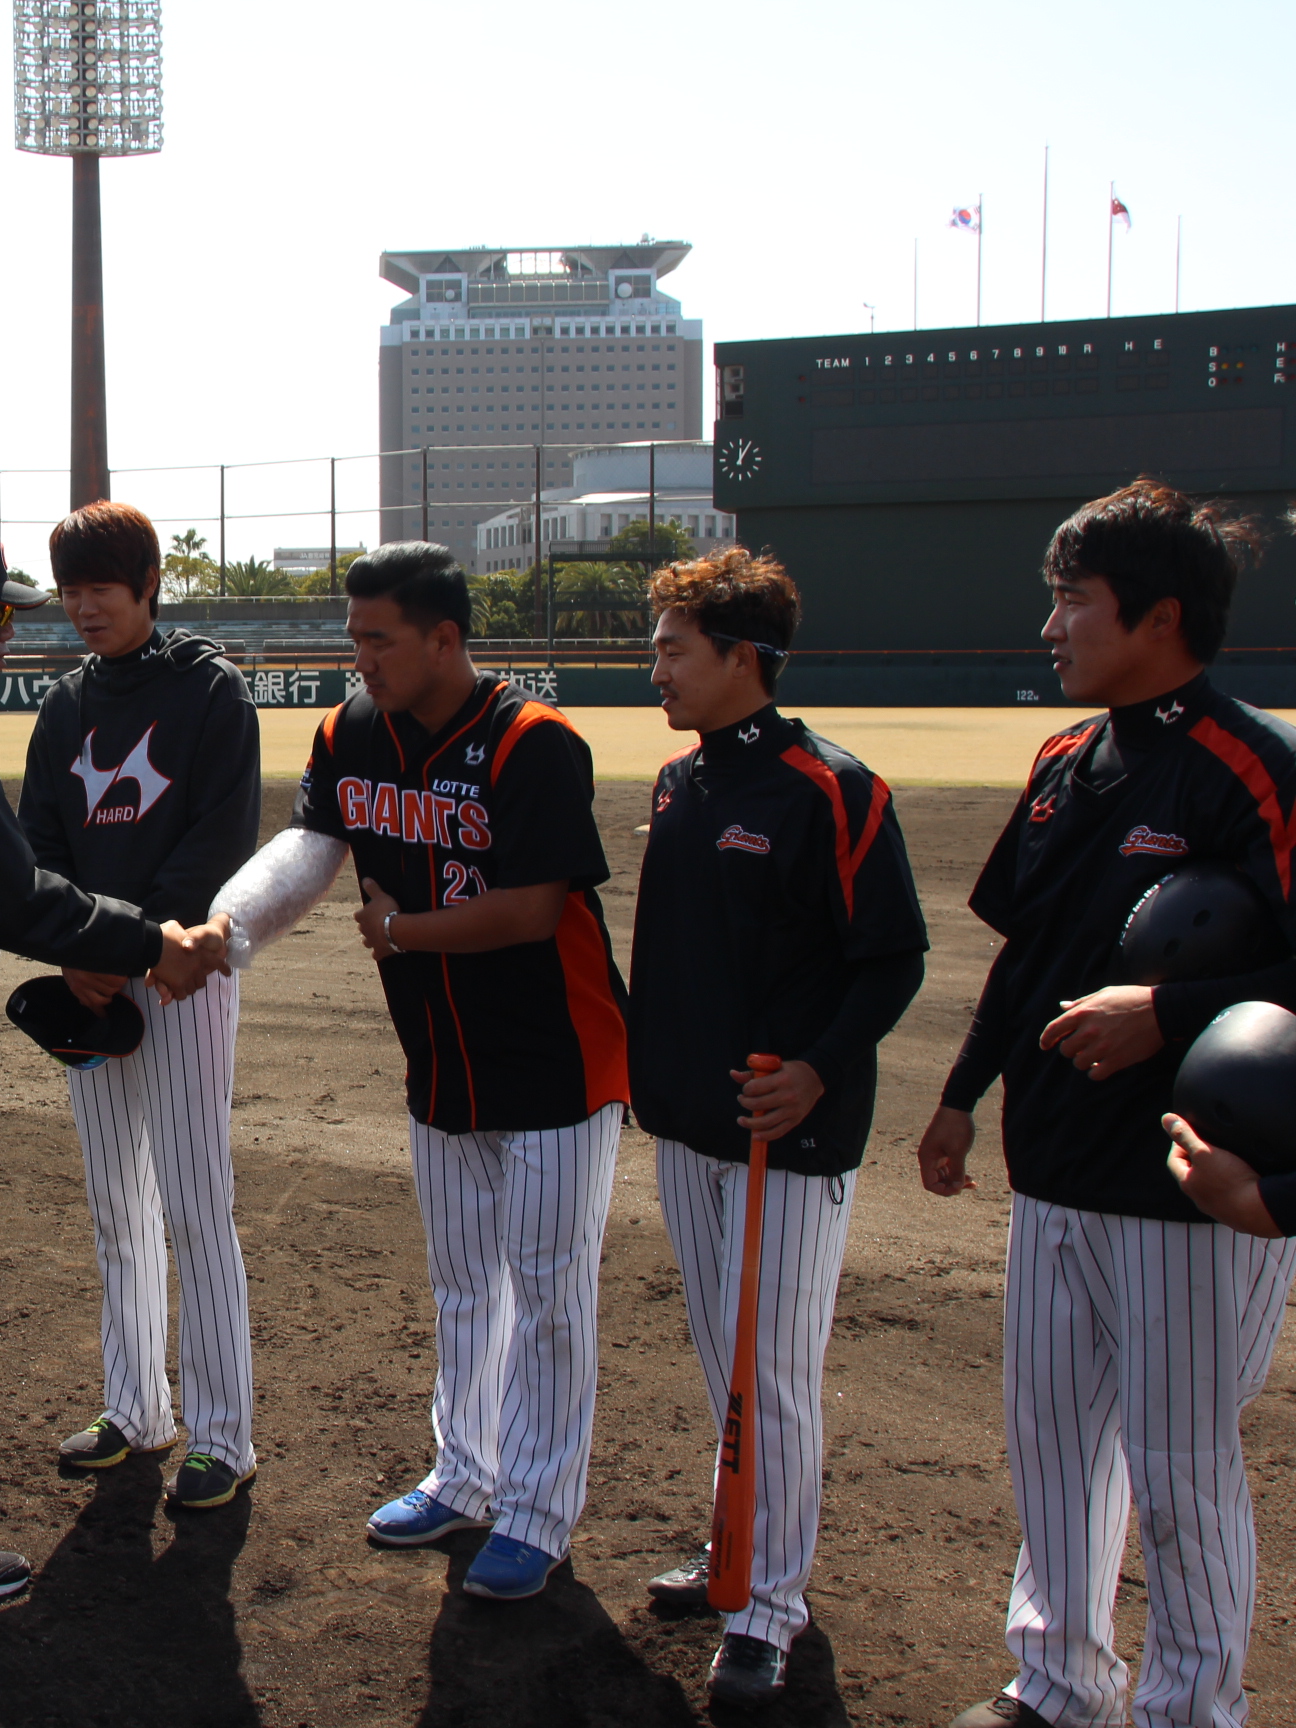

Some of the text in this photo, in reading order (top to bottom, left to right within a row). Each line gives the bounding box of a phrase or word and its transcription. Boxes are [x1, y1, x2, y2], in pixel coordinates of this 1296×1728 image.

[816, 339, 1162, 369] TEAM 1 2 3 4 5 6 7 8 9 10 R H E
[1209, 346, 1218, 357] B
[1276, 342, 1286, 352] H
[1208, 362, 1217, 372] S
[1276, 357, 1285, 368] E
[244, 671, 320, 703] 銀行
[432, 778, 480, 798] LOTTE
[95, 806, 134, 825] HARD
[337, 776, 492, 850] GIANTS
[443, 860, 487, 906] 21
